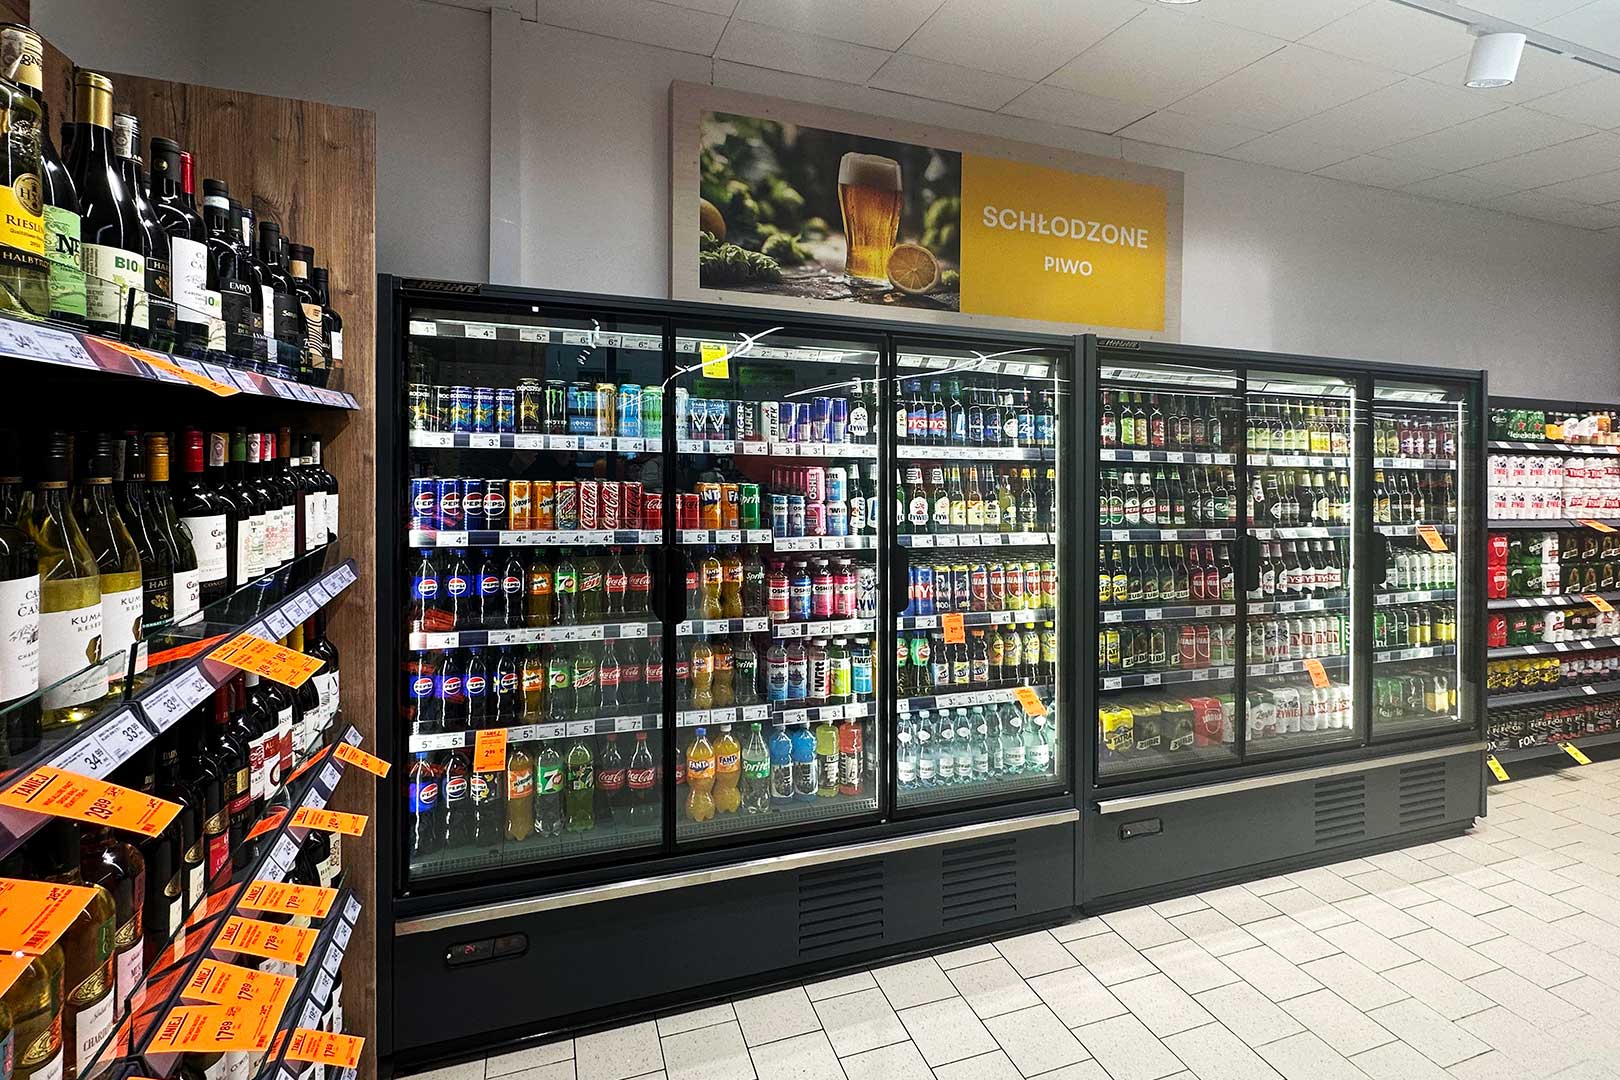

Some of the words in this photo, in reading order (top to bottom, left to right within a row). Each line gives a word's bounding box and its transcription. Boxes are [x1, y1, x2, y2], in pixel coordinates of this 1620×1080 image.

[983, 206, 1149, 248] SCHŁODZONE
[1044, 256, 1093, 276] PIWO
[11, 773, 50, 798] TANIEJ
[191, 967, 213, 989] TANIEJ
[158, 1016, 184, 1043] TANIEJ
